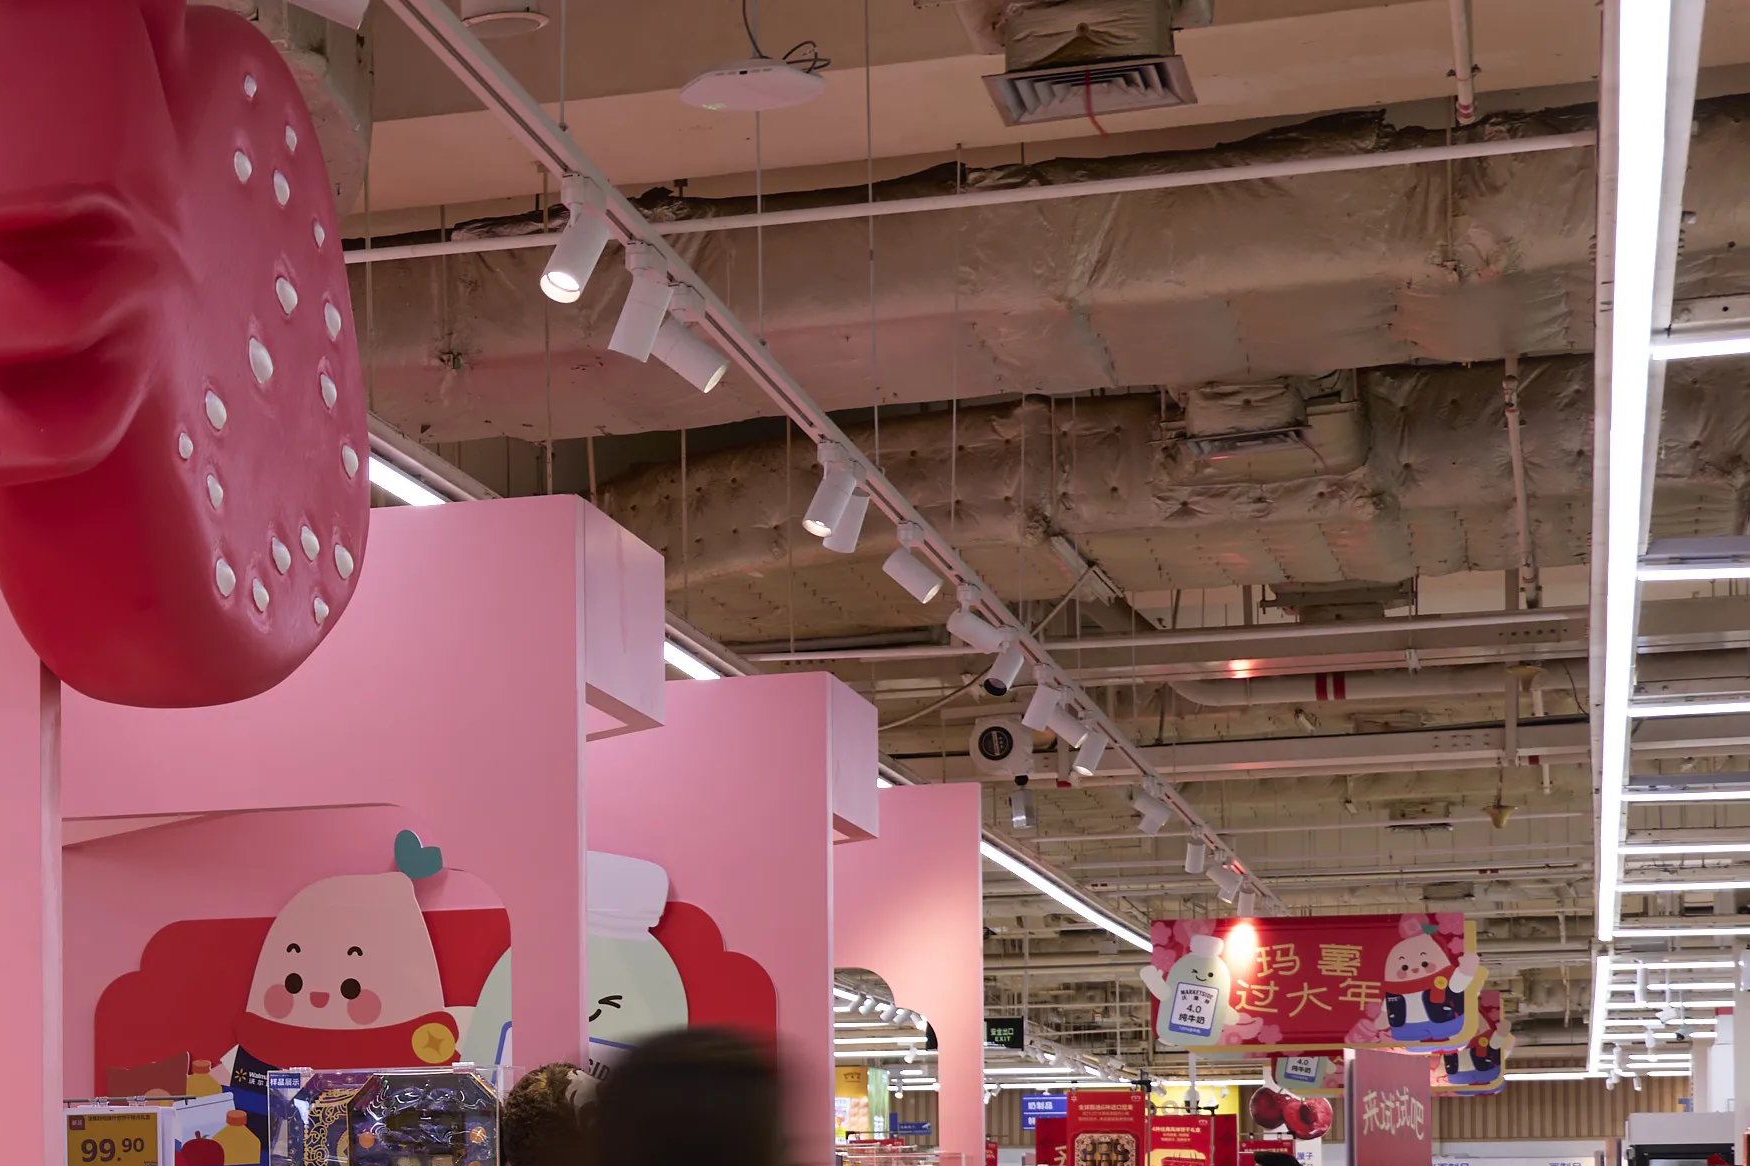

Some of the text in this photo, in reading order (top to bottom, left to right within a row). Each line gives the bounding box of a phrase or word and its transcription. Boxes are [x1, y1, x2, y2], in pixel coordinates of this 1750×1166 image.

[1256, 943, 1362, 977] 玛薯
[1180, 989, 1214, 1000] MARKETSIDE
[1235, 978, 1382, 1017] 过大年
[1186, 1005, 1202, 1013] 4.0
[1178, 1012, 1205, 1024] 纯牛奶
[1291, 1065, 1311, 1074] 纯牛奶
[270, 1077, 300, 1086] 样品展示
[1028, 1101, 1053, 1110] 奶制品
[81, 1137, 145, 1163] 99.90
